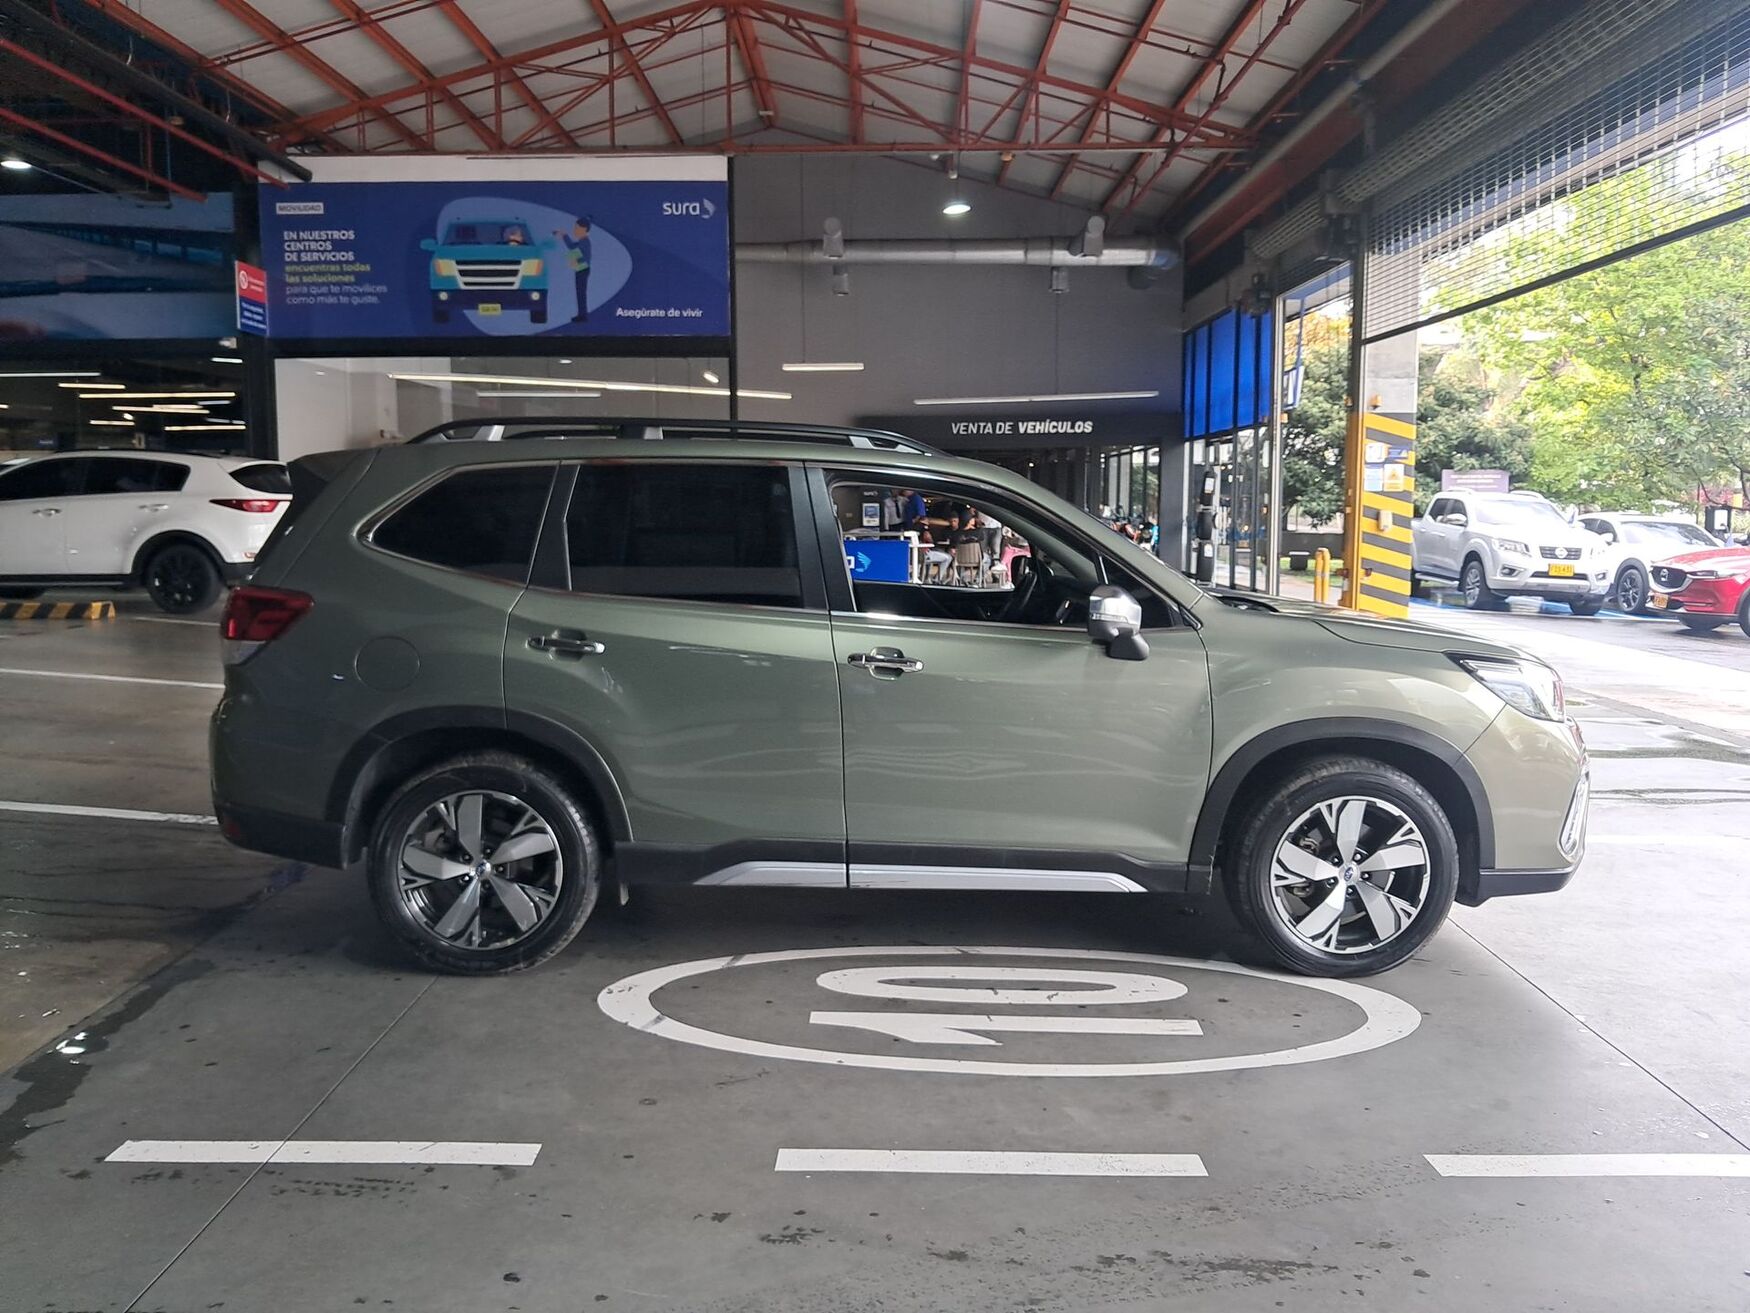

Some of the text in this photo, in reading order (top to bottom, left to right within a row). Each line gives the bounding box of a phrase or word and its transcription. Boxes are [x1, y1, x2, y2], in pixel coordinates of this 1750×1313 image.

[662, 202, 700, 216] sura
[283, 230, 355, 240] EN NUESTROS
[284, 241, 332, 251] CENTROS
[285, 252, 355, 261] DE SERVICIOS
[302, 274, 356, 283] soluciones
[616, 307, 704, 319] Asegúrate de vivir
[951, 419, 1094, 435] VENTA DE VEHÍCULOS
